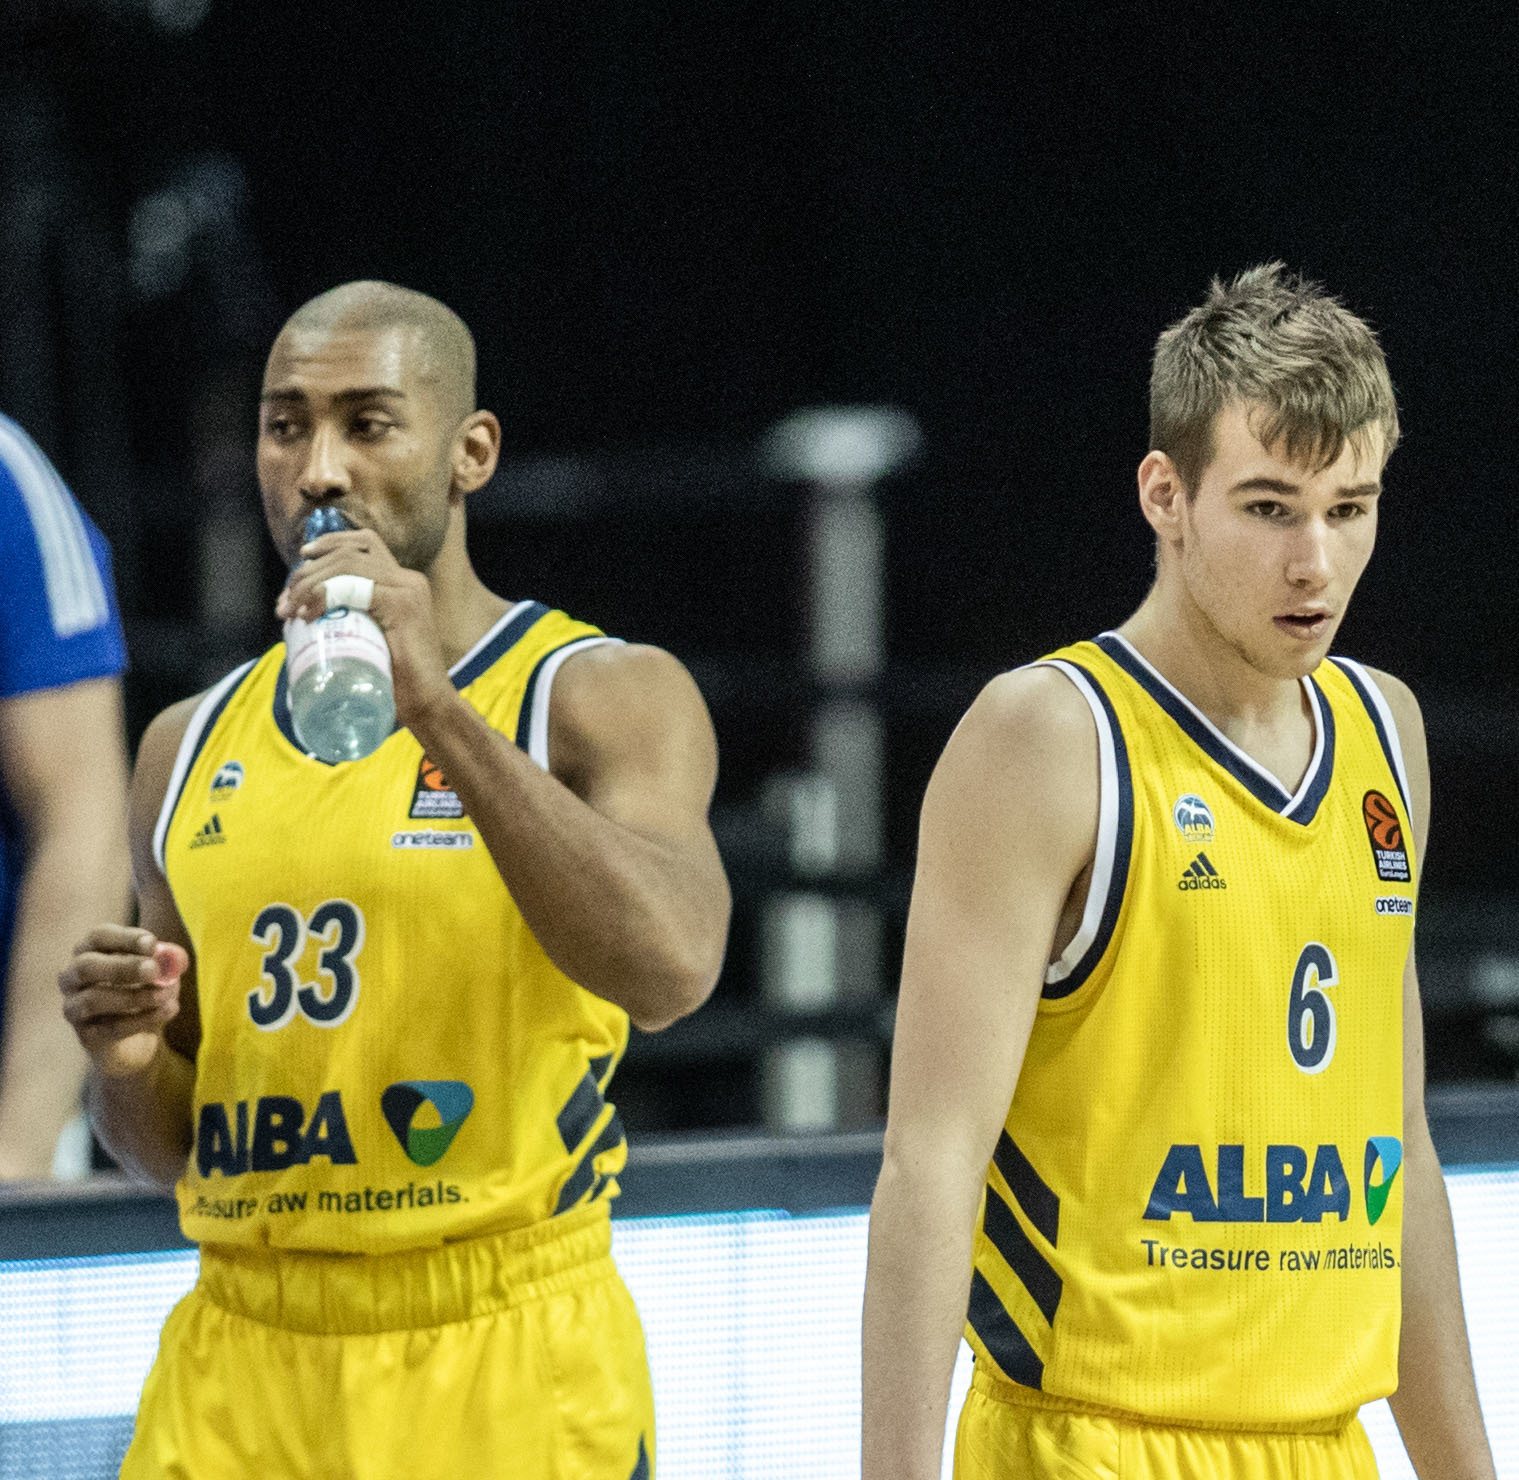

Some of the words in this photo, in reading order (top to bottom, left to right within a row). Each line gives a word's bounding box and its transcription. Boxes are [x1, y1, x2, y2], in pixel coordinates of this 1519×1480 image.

[1178, 876, 1227, 891] adidas
[248, 898, 365, 1031] 33
[1287, 940, 1339, 1075] 6
[196, 1090, 359, 1180] ALBA
[267, 1190, 309, 1215] aw
[318, 1181, 470, 1213] materials.
[1142, 1144, 1351, 1224] ALBA
[1140, 1239, 1270, 1271] Treasure
[1279, 1249, 1321, 1271] raw
[1322, 1241, 1402, 1270] materials.
